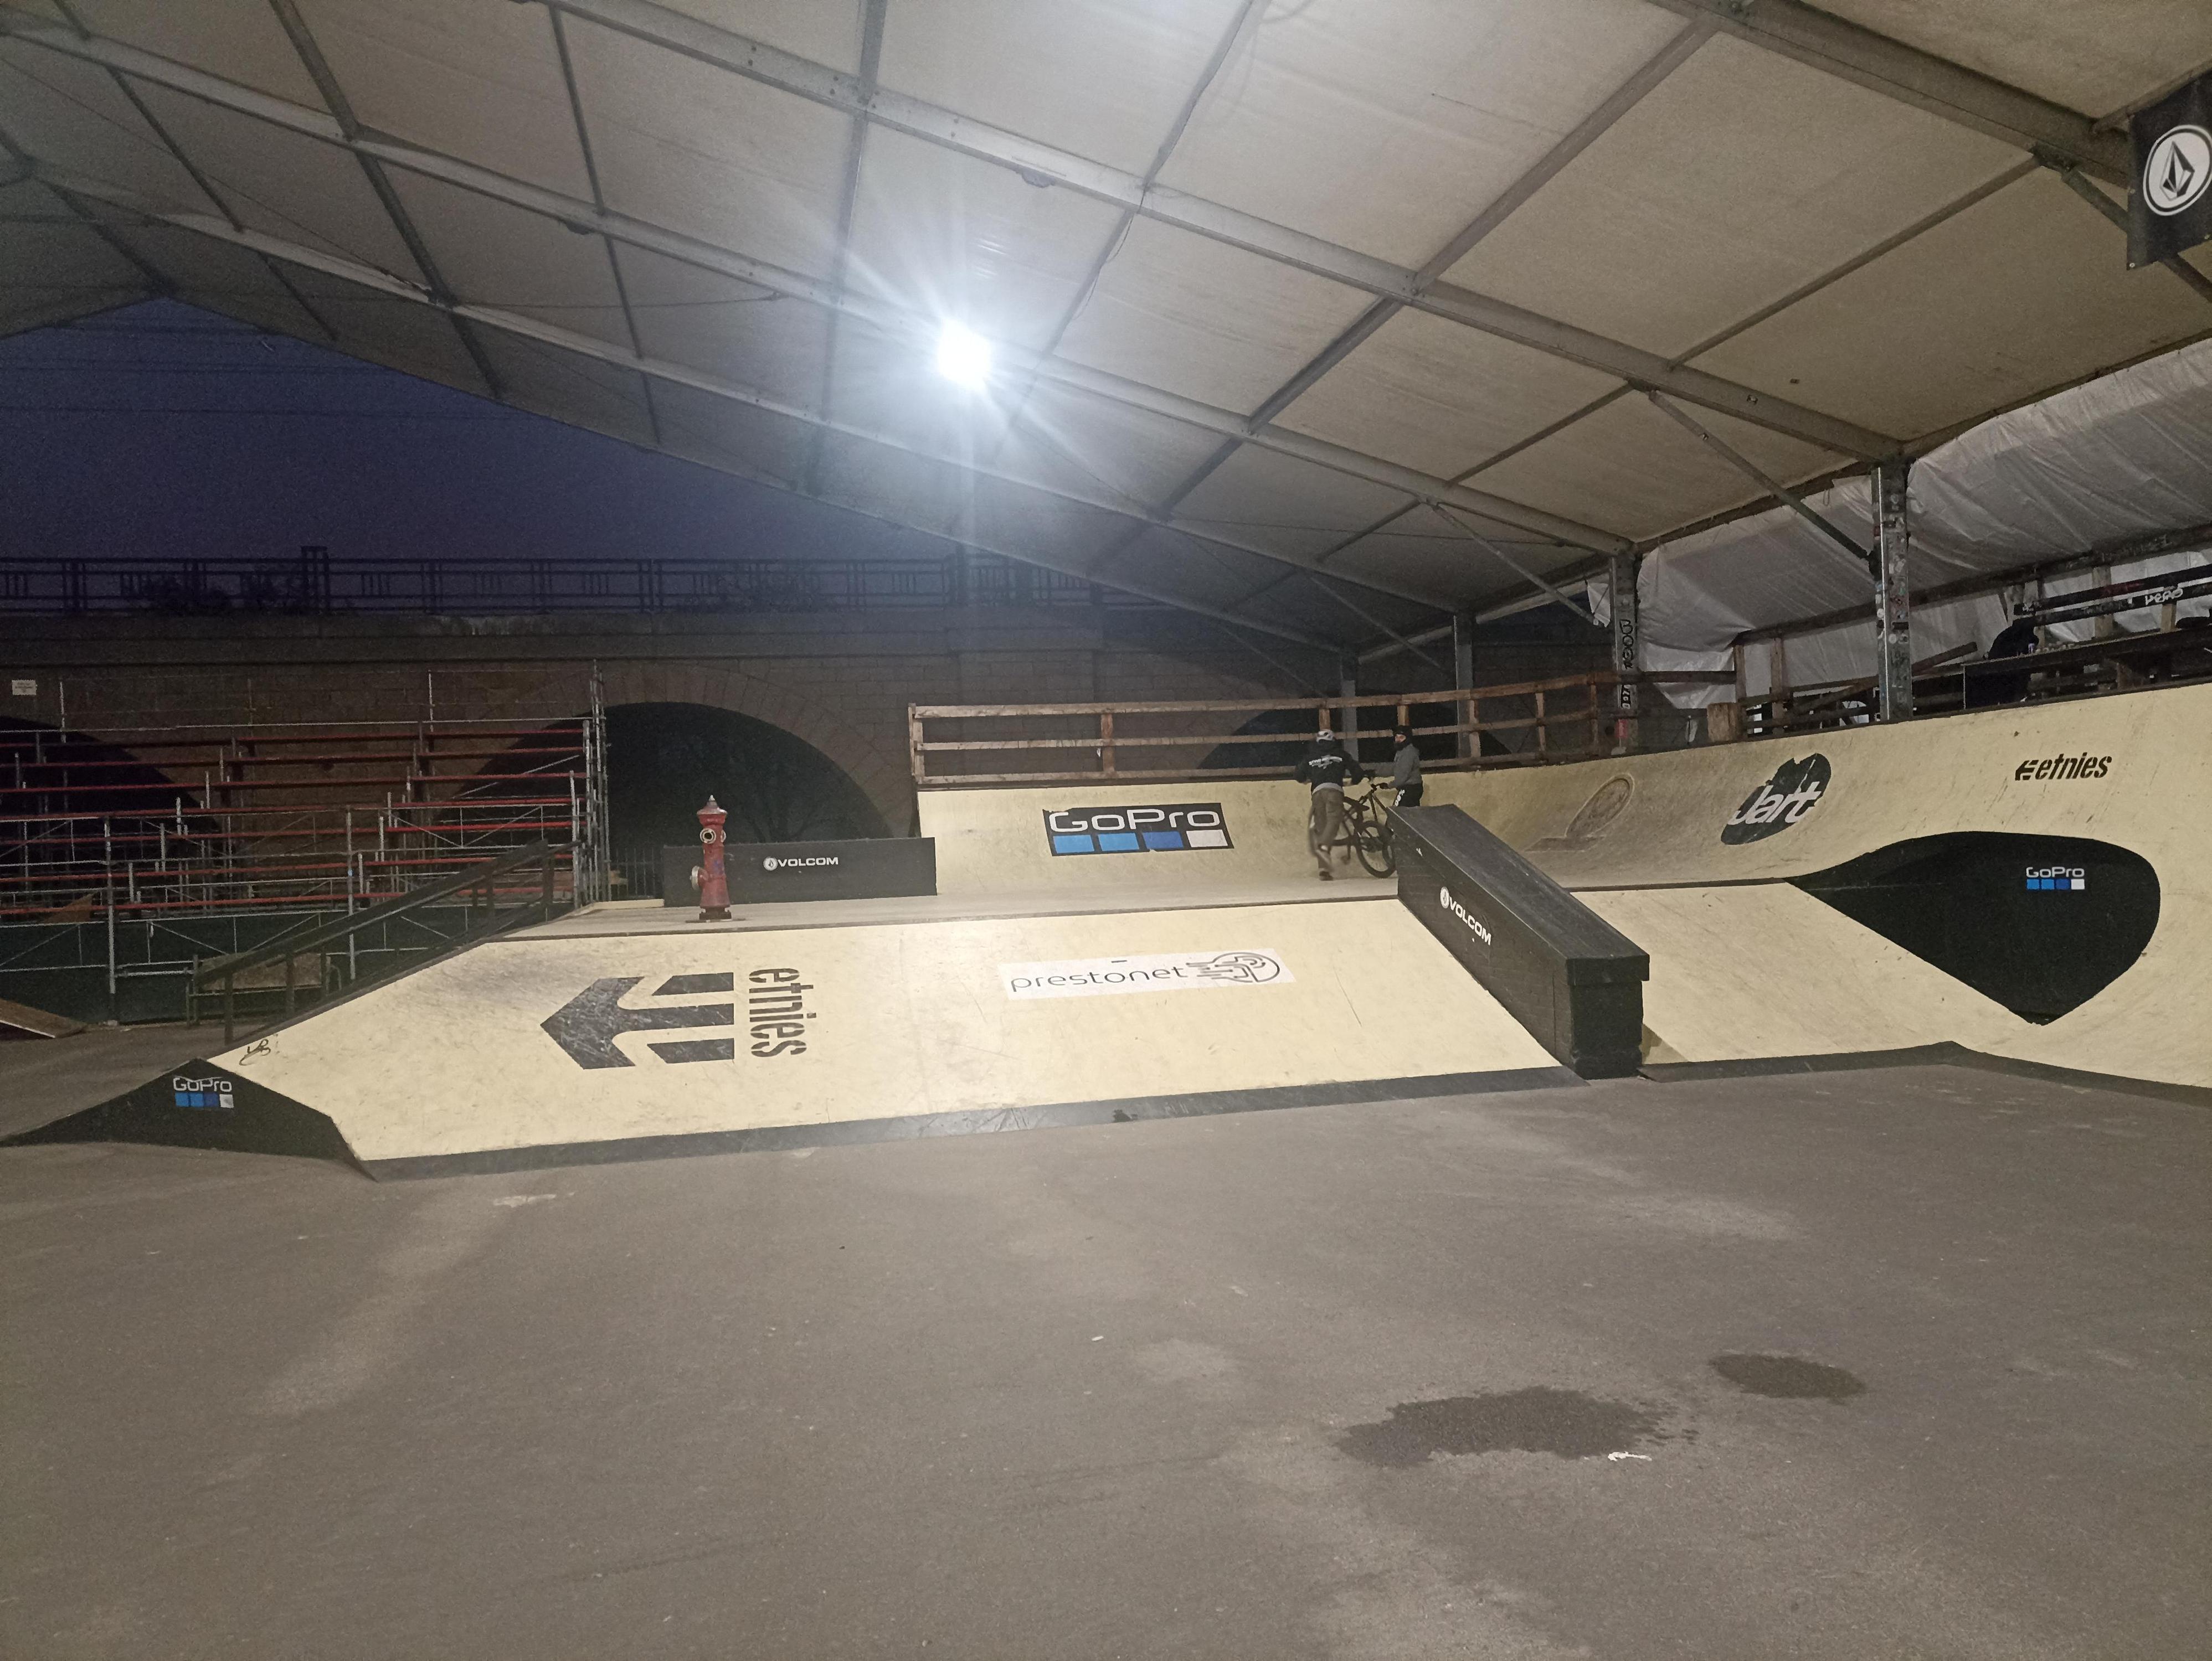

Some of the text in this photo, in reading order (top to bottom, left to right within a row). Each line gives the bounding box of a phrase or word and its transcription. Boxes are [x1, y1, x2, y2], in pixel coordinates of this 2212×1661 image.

[2035, 752, 2112, 780] etnies
[1727, 781, 1822, 826] Jart
[1048, 808, 1221, 833] GoPro
[778, 857, 838, 868] VOLCOM
[2025, 866, 2085, 878] GoPro
[1449, 896, 1492, 946] VOLCOM
[749, 968, 817, 1058] etnies
[172, 1077, 233, 1092] GoPro
